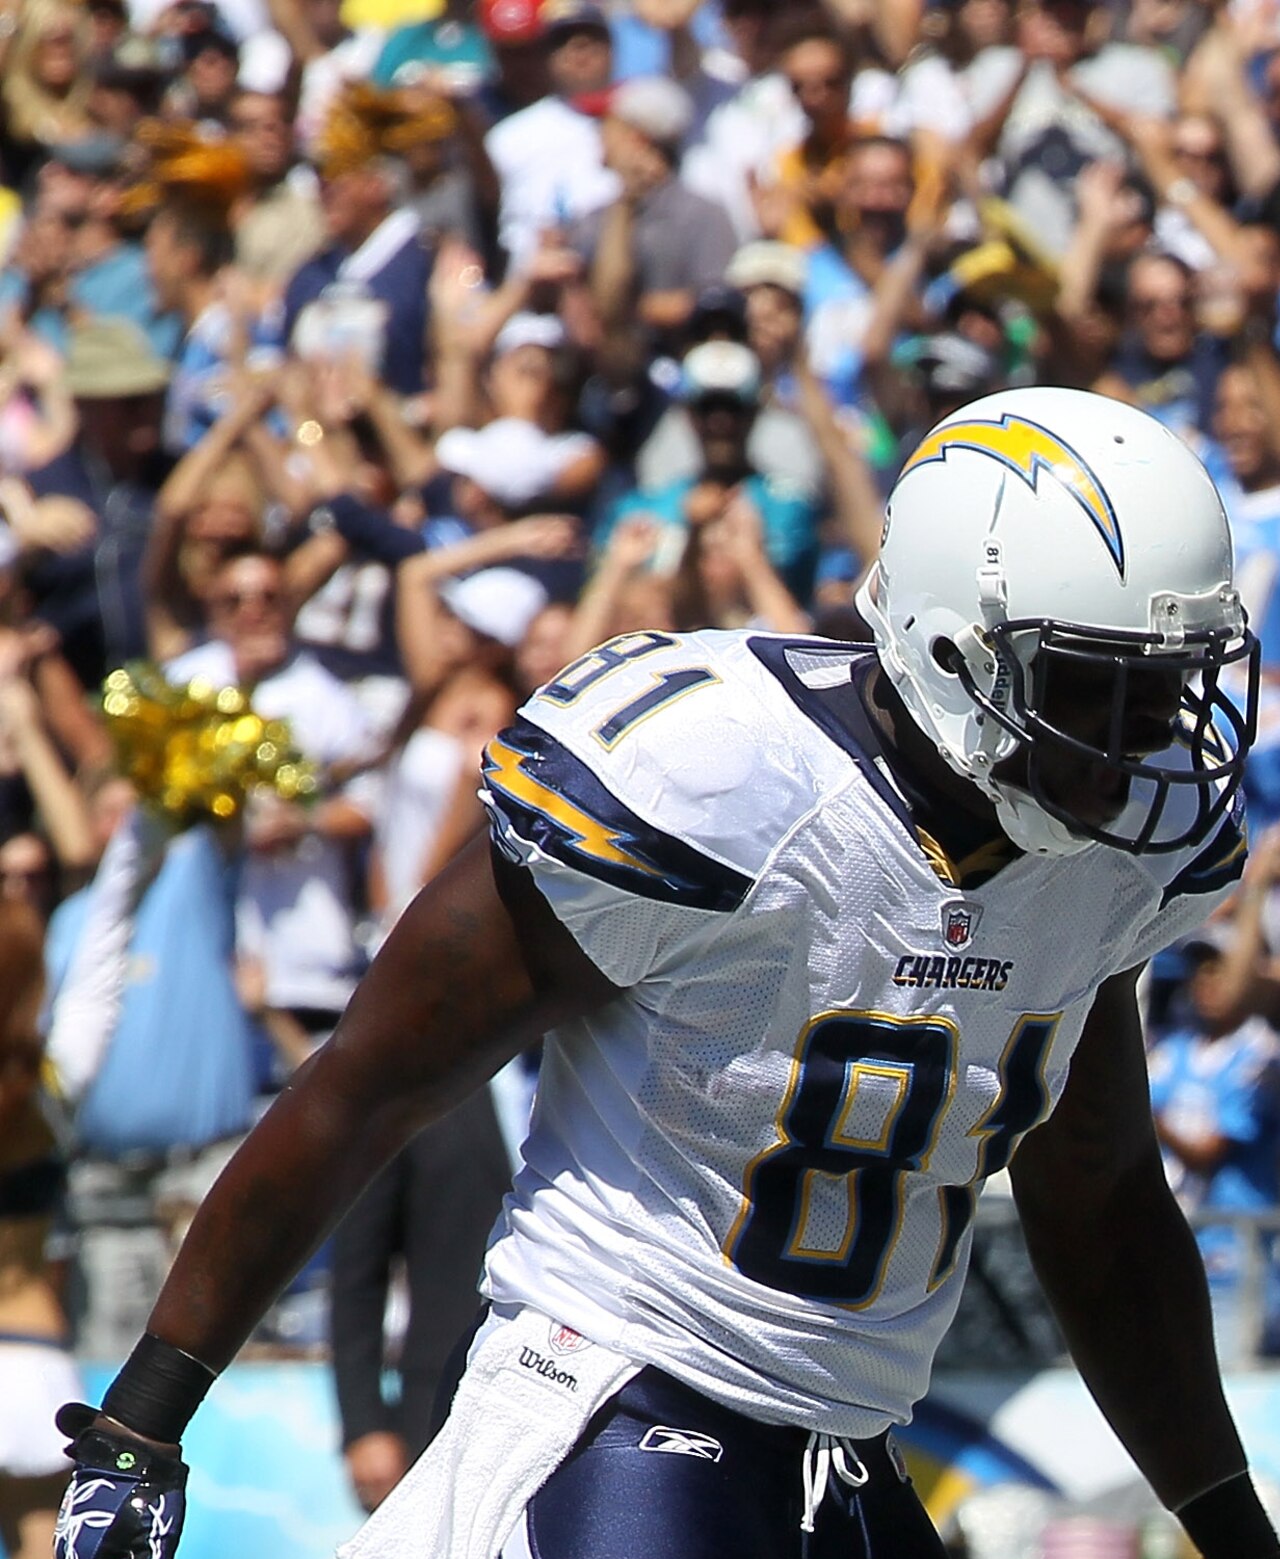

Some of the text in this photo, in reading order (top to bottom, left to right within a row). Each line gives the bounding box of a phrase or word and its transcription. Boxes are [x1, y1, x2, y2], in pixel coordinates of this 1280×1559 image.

[985, 546, 1000, 566] 81
[536, 629, 724, 754] 81
[891, 955, 1014, 992] CHARGERS
[720, 1008, 1065, 1312] 81
[518, 1346, 579, 1394] Wilson
